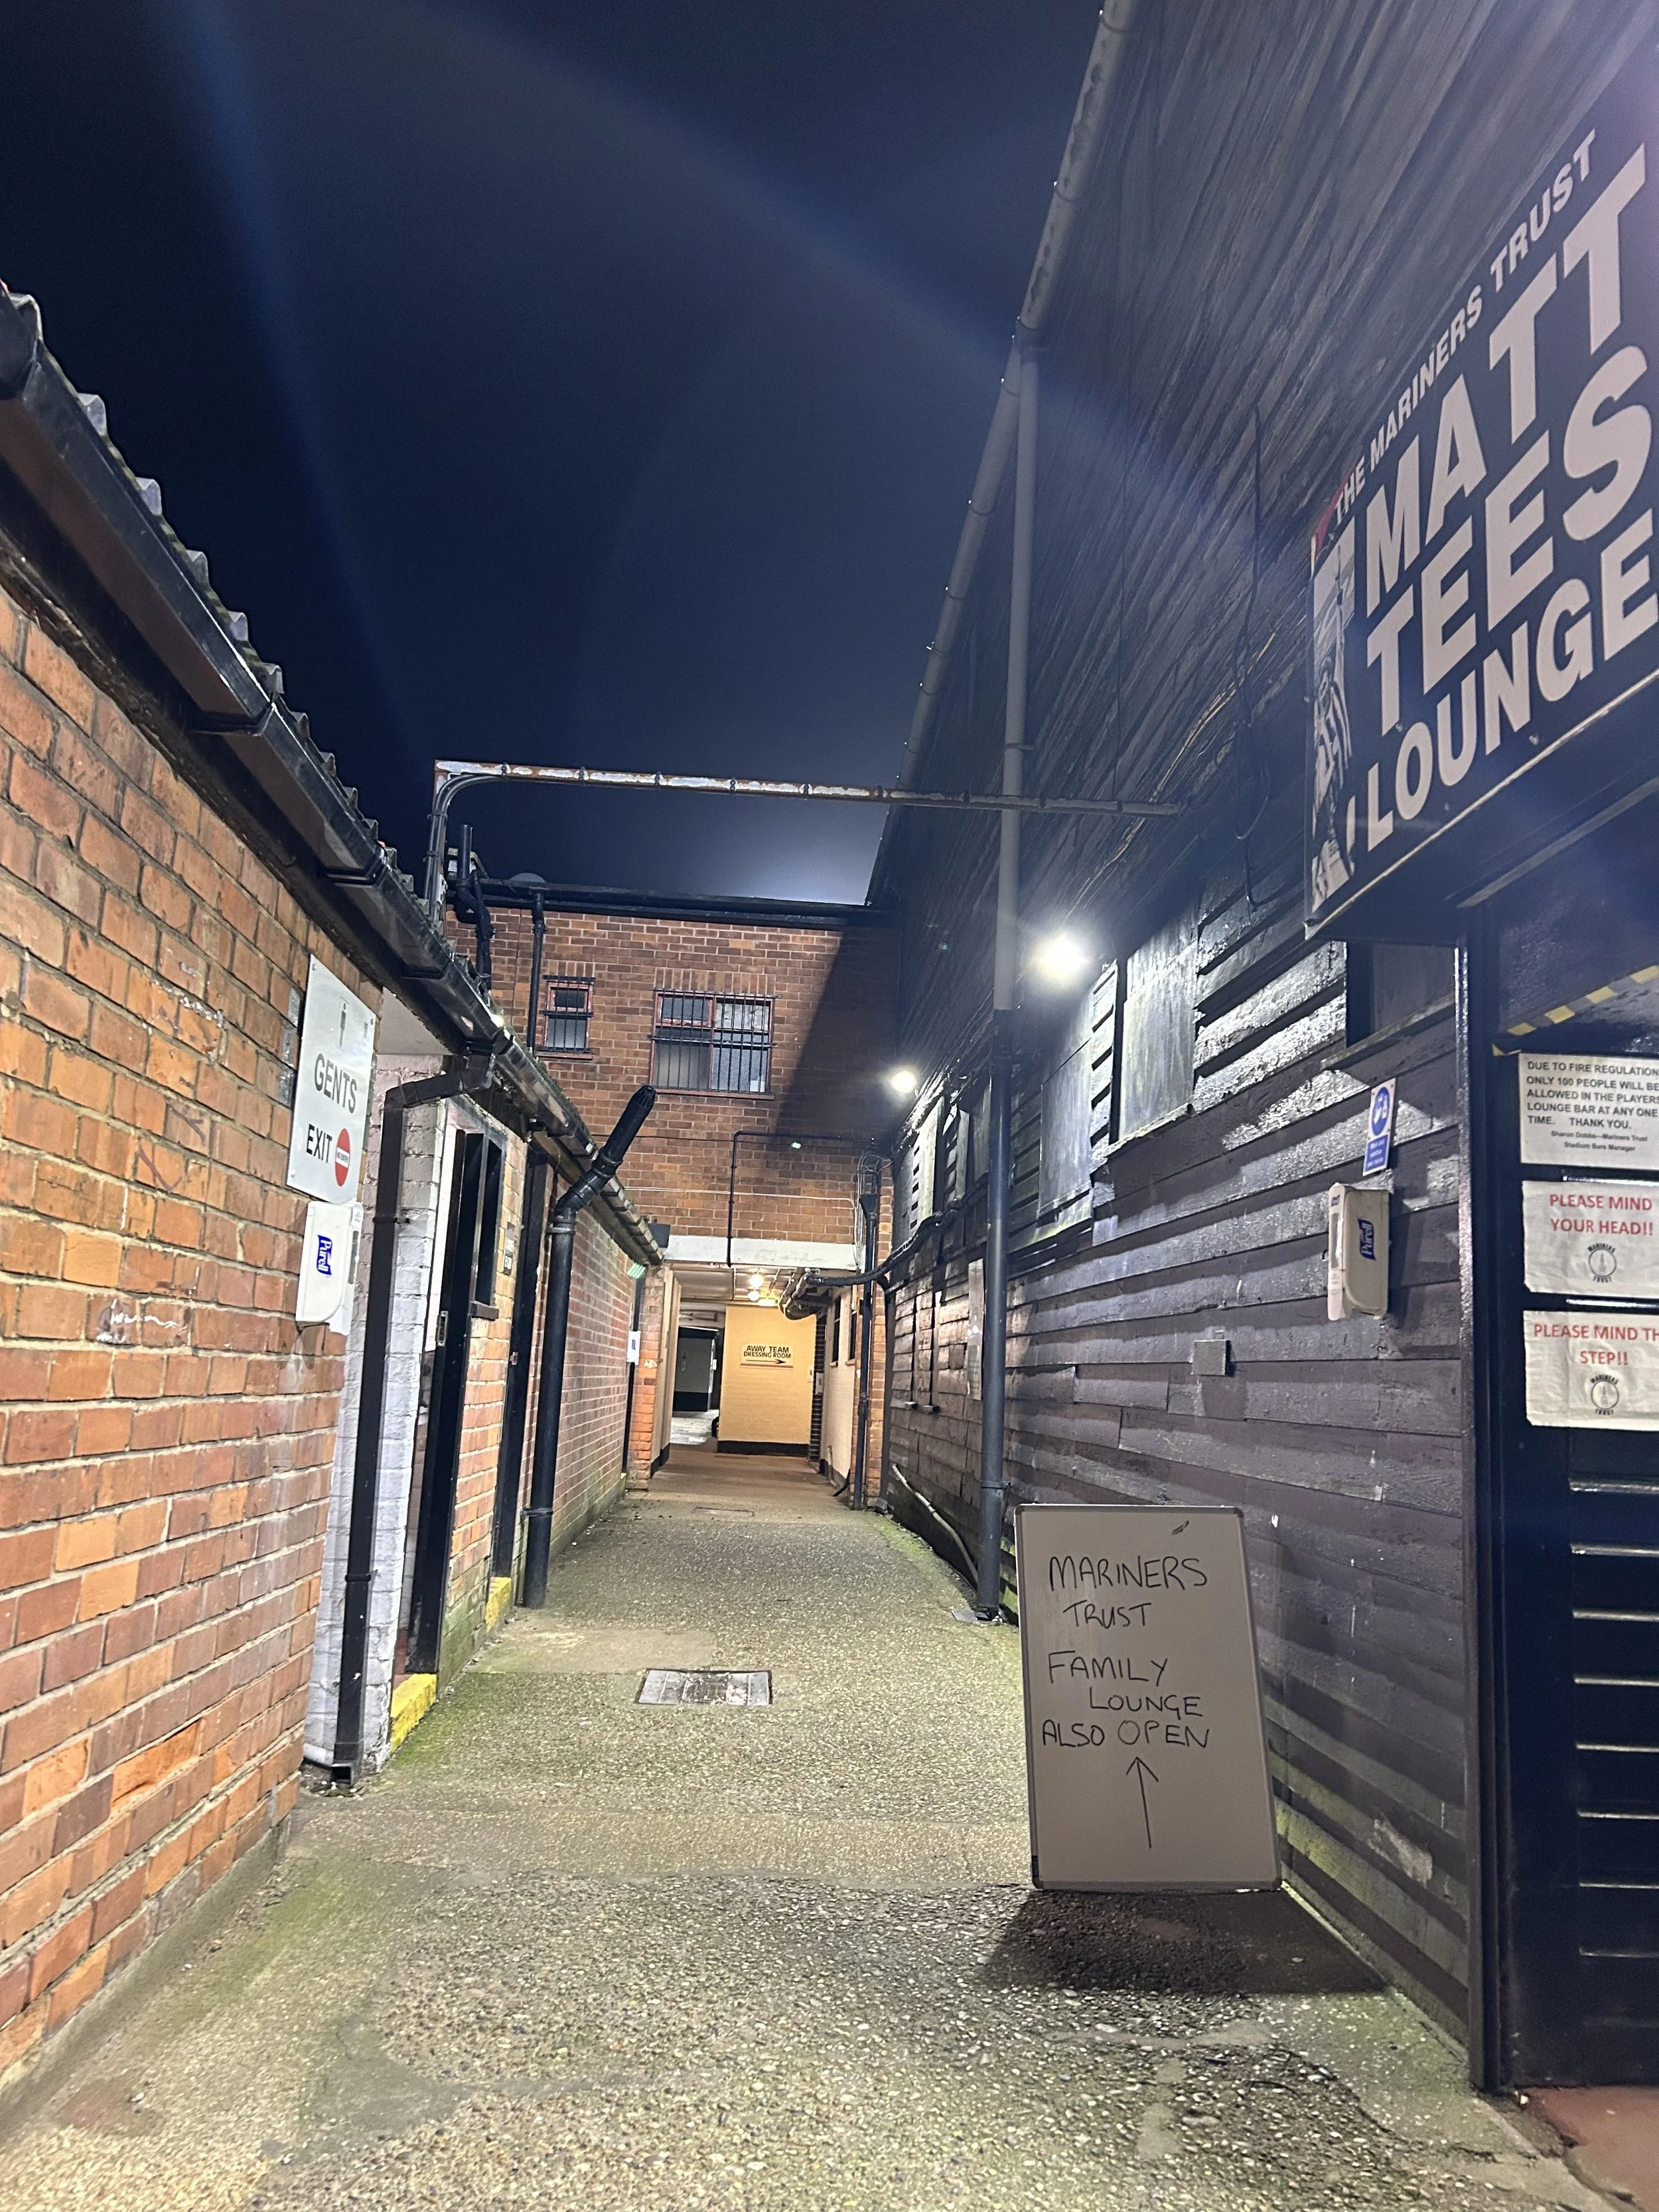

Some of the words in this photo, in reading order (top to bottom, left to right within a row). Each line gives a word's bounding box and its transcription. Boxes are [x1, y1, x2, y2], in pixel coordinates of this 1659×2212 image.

[1334, 455, 1365, 525] THE
[1370, 285, 1482, 473] MARINERS
[1490, 128, 1595, 293] TRUST
[1366, 143, 1646, 618] MATT
[1367, 345, 1652, 737] TEES
[1368, 508, 1658, 852] LOUNGE
[1528, 1062, 1550, 1070] DUE
[1552, 1062, 1567, 1071] TO
[1569, 1063, 1591, 1072] FIRE
[315, 1053, 358, 1114] GENTS
[1527, 1076, 1554, 1084] ONLY
[1576, 1078, 1617, 1088] PEOPLE
[1619, 1080, 1644, 1090] WILL
[1646, 1082, 1659, 1091] BE
[1527, 1089, 1579, 1100] ALLOWED
[1581, 1091, 1591, 1100] IN
[1594, 1092, 1614, 1102] THE
[1528, 1102, 1571, 1112] LOUNGE
[1574, 1104, 1595, 1114] BAR
[1598, 1106, 1611, 1115] AT
[1613, 1106, 1634, 1116] ANY
[1636, 1108, 1658, 1117] ONE
[1527, 1115, 1555, 1125] TIME.
[1569, 1118, 1605, 1128] THANK
[1607, 1119, 1632, 1130] YOU.
[306, 1123, 332, 1163] EXIT
[1608, 1144, 1636, 1153] Manager
[1550, 1194, 1604, 1209] PLEASE
[1609, 1196, 1653, 1211] MIND
[1550, 1218, 1594, 1233] YOUR
[1599, 1220, 1653, 1236] HEAD!!
[1587, 1242, 1616, 1254] MARINERS
[1534, 1324, 1589, 1339] PLEASE
[1594, 1325, 1638, 1341] MIND
[1580, 1351, 1628, 1366] STEP!!
[1049, 1555, 1208, 1591] MARINERS
[1062, 1599, 1152, 1629] TRUST
[1048, 1650, 1168, 1687] FAMILY
[1089, 1686, 1203, 1721] LOUNGE
[1042, 1719, 1105, 1747] ALSO
[1118, 1720, 1210, 1749] OPEN
